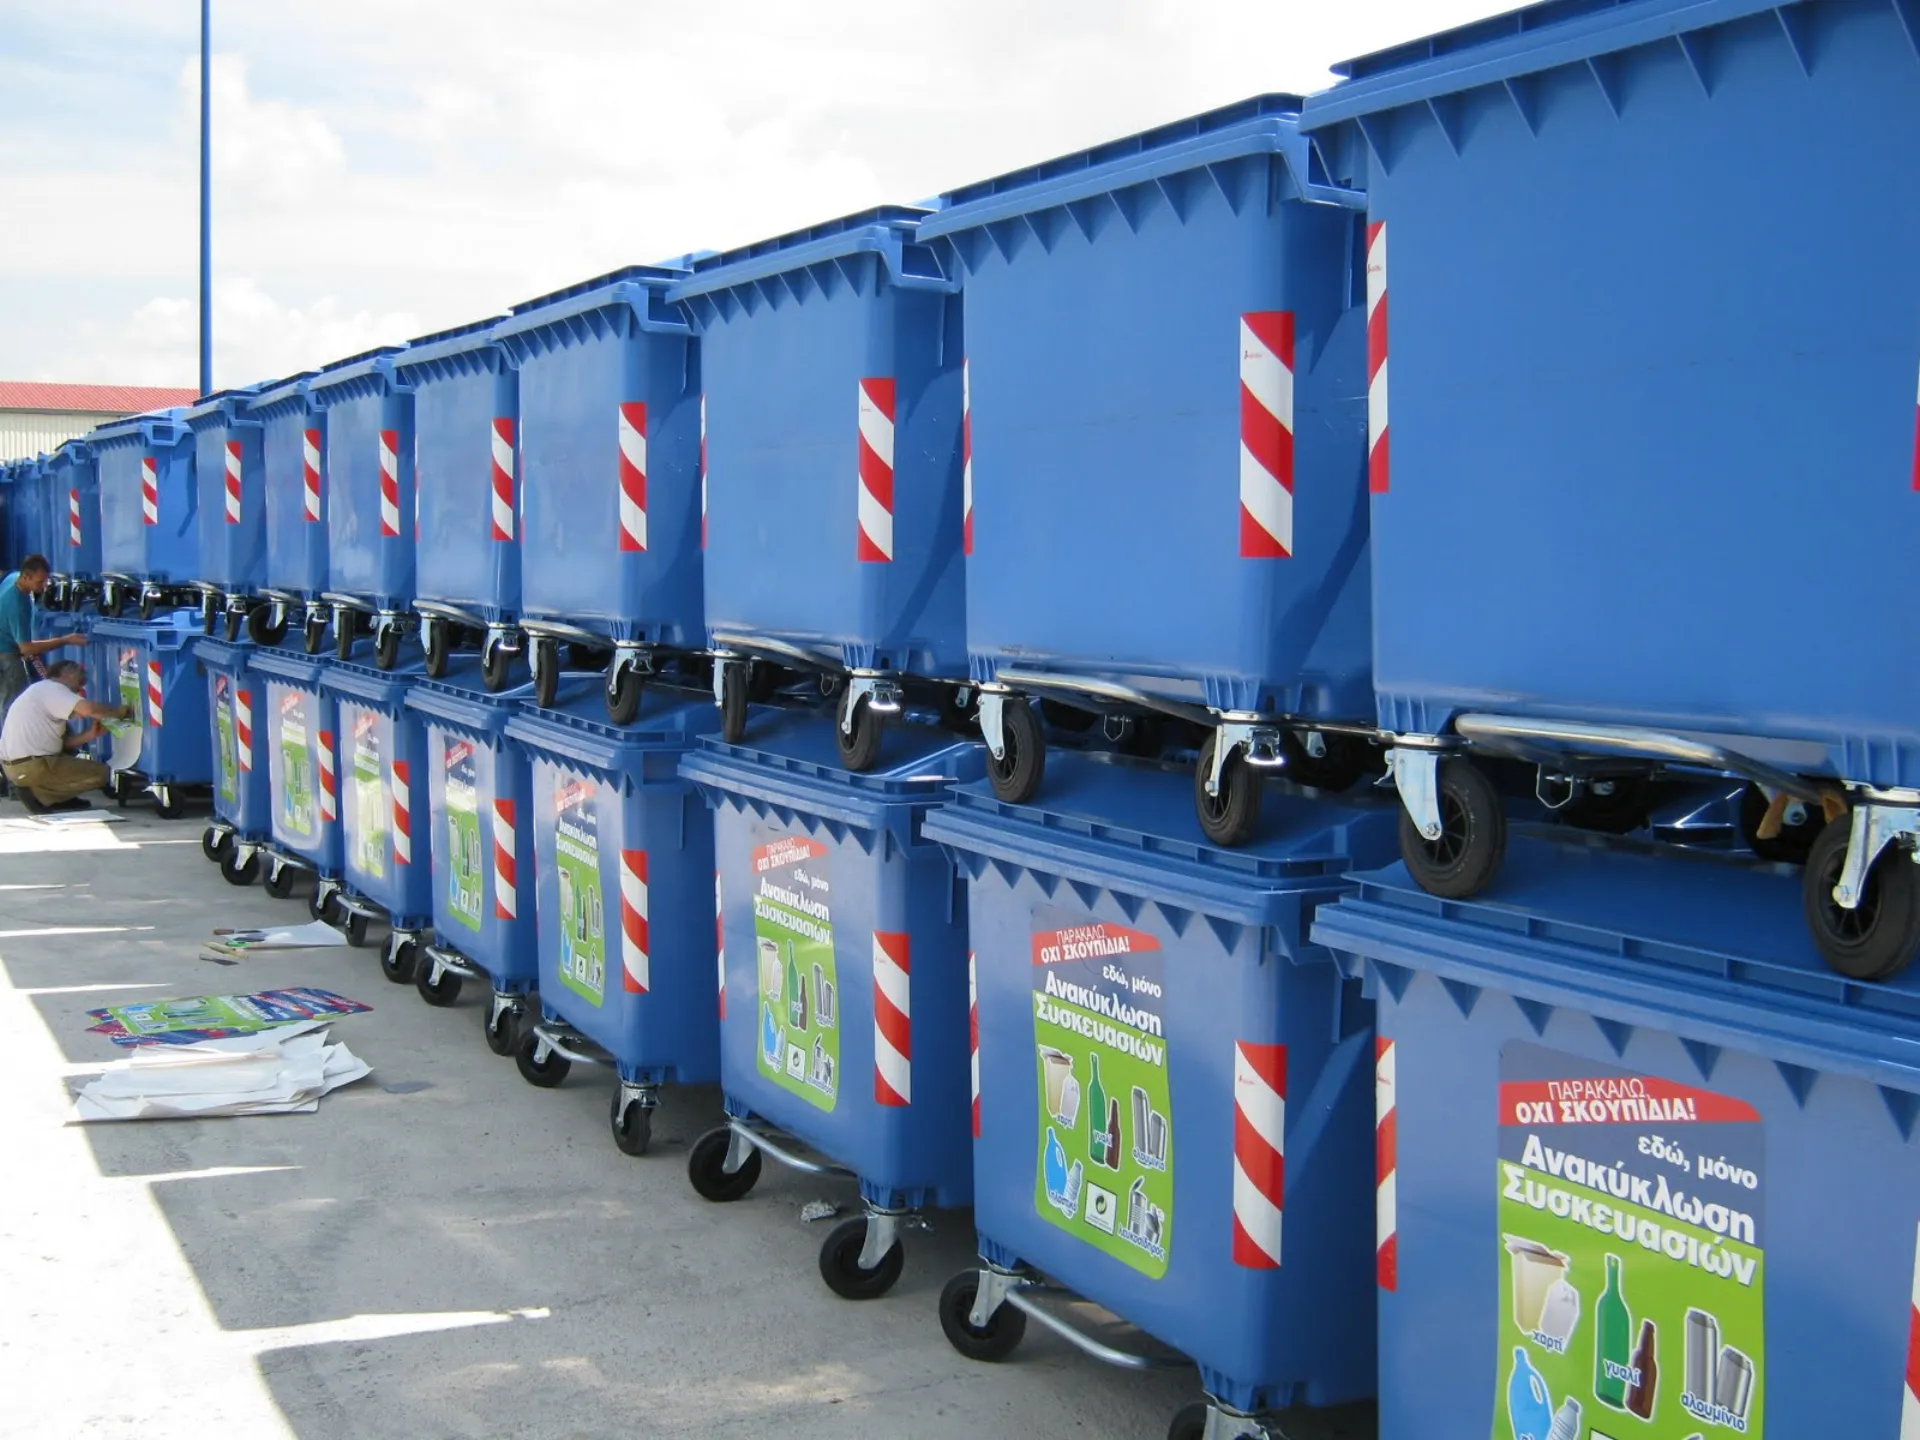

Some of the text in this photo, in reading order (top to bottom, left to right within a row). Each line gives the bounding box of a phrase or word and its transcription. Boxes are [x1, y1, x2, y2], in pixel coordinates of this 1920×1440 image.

[761, 876, 829, 921] Ανακύκλωση
[1041, 936, 1130, 964] ΟΧΙ ΣΚΟΥΠΙΔΙΑ!
[1103, 963, 1161, 998] εδώ, μόνο
[1045, 970, 1162, 1036] Ανακύκλωση
[1036, 993, 1163, 1066] Συσκευασιών
[1515, 1097, 1697, 1124] ΟΧΙ ΣΚΟΥΠΙΔΙΑ!
[1638, 1135, 1758, 1190] εδώ, μόνο
[1521, 1134, 1755, 1244] Ανακύκλωση
[1502, 1163, 1757, 1287] Συσκευασιών
[1532, 1330, 1564, 1352] χαρτί
[1604, 1360, 1641, 1387] γυαλί
[1681, 1394, 1746, 1431] αλουμίνιο
